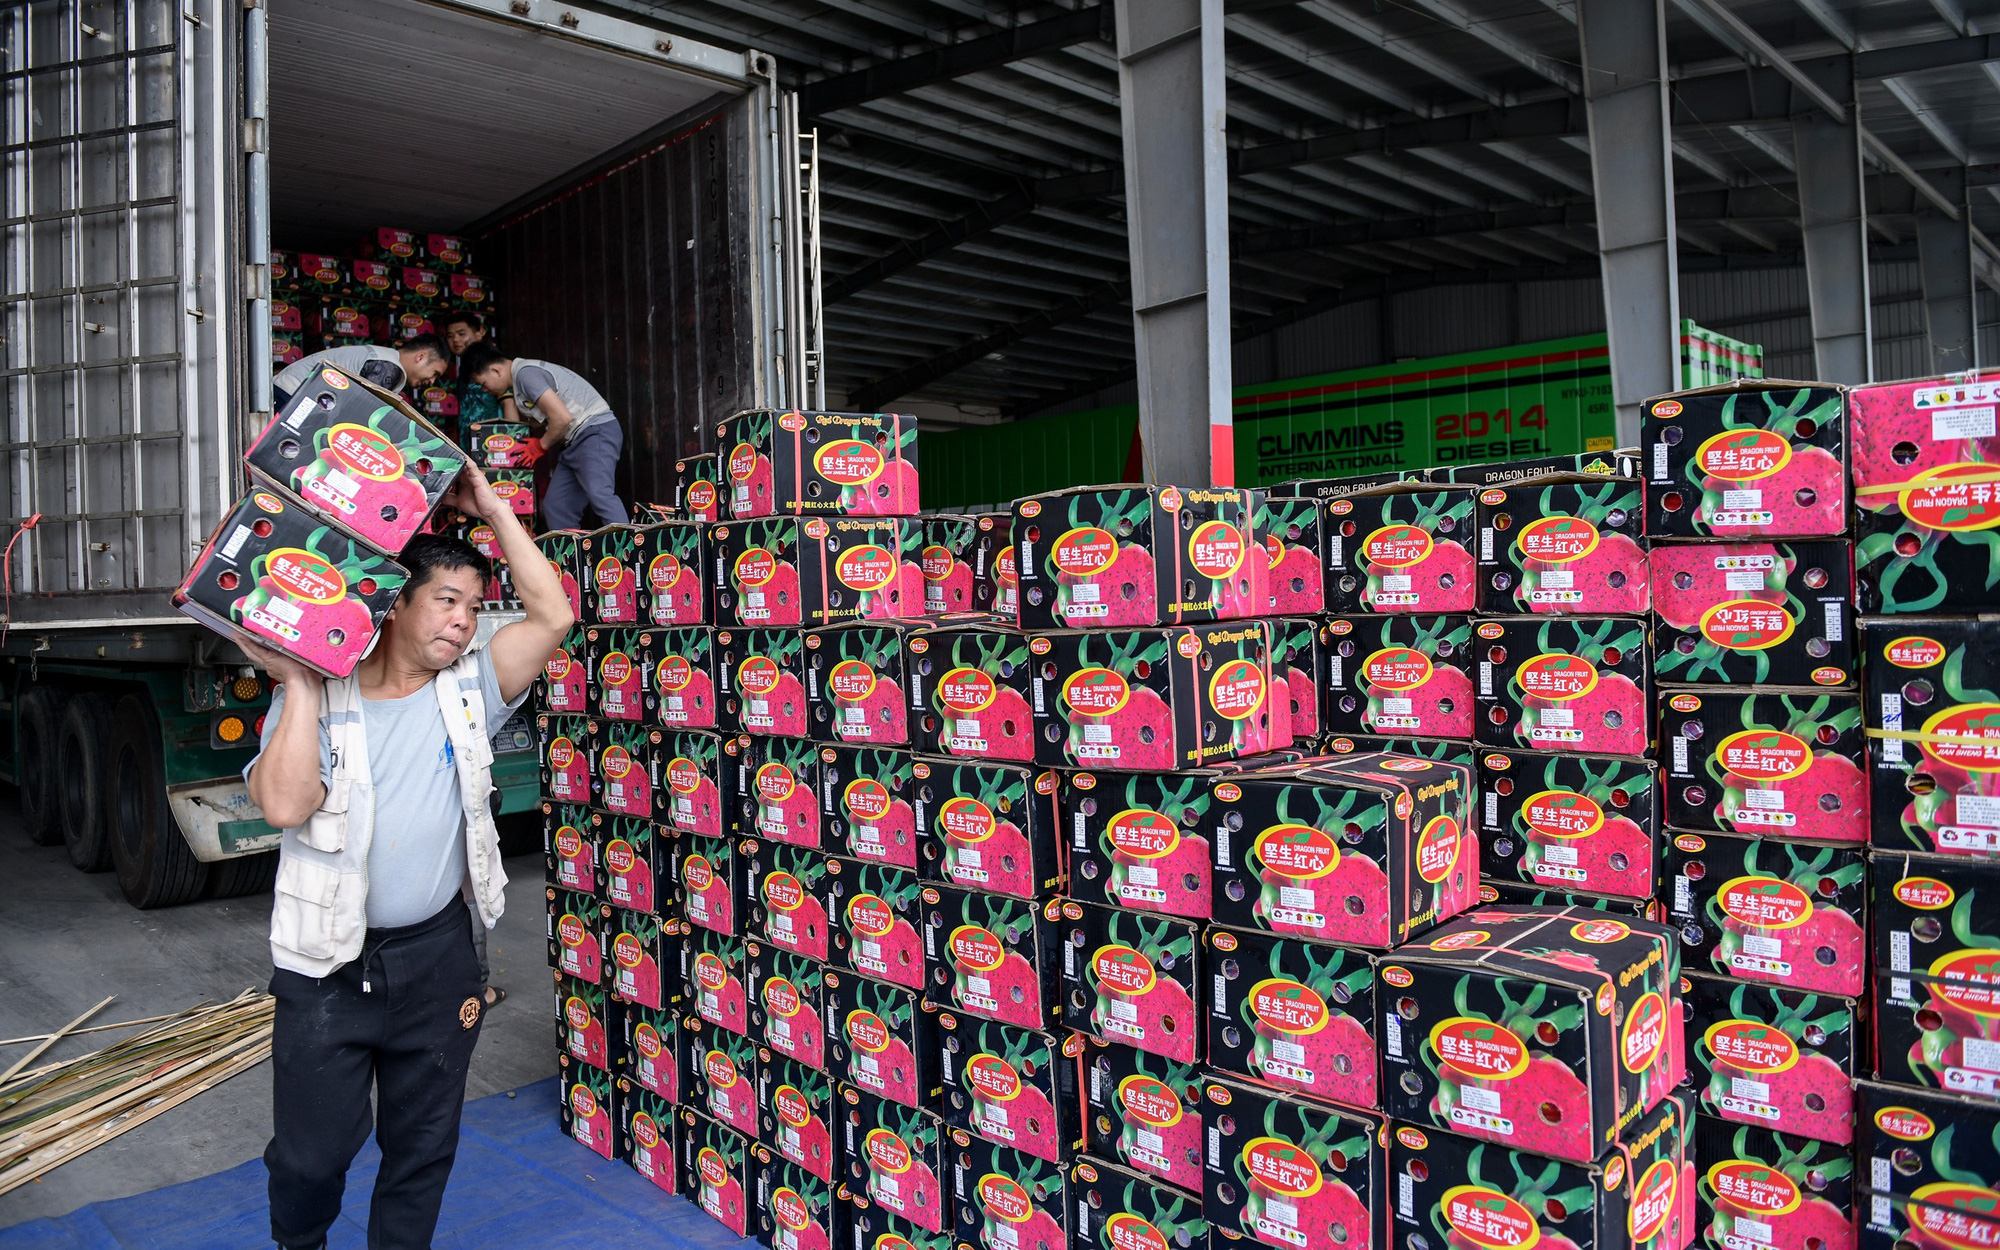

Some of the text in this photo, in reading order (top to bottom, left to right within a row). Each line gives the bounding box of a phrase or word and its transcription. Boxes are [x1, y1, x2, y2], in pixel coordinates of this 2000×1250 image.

[1436, 404, 1549, 440] 2014
[1258, 421, 1404, 457] CUMMINS
[1437, 438, 1550, 462] DIESEL
[1740, 447, 1763, 455] DRAGON
[356, 452, 383, 476] 红心
[364, 447, 397, 470] DRAGON FRUIT
[1258, 451, 1404, 477] INTERNATIONAL
[1740, 455, 1774, 470] 红心
[847, 464, 872, 477] 红心
[1486, 469, 1524, 482] DRAGON
[1318, 484, 1350, 496] DRAGON
[1913, 496, 1968, 508] DRAGON FRUIT
[1395, 546, 1420, 559] 红心
[1555, 540, 1584, 553] 红心
[1082, 552, 1106, 566] 红心
[1215, 551, 1235, 568] 红心
[296, 576, 325, 600] 红心
[1716, 609, 1749, 623] 红心
[1554, 678, 1583, 692] 红心
[965, 691, 986, 704] 红心
[1094, 693, 1118, 707] 红心
[1761, 757, 1795, 772] 红心
[966, 821, 986, 836] 红心
[1294, 845, 1314, 853] DRAGON
[1294, 853, 1324, 871] 红心
[869, 916, 885, 930] 红心
[975, 949, 995, 965] 红心
[1122, 963, 1148, 976] DRAGON FRUIT
[1122, 971, 1144, 989] 红心
[1944, 990, 1963, 998] JIAN
[1286, 1008, 1314, 1028] 红心
[1476, 1040, 1517, 1055] DRAGON FRUIT
[1748, 1040, 1787, 1052] DRAGON FRUIT
[1476, 1050, 1511, 1072] 红心
[1748, 1048, 1781, 1067] 红心
